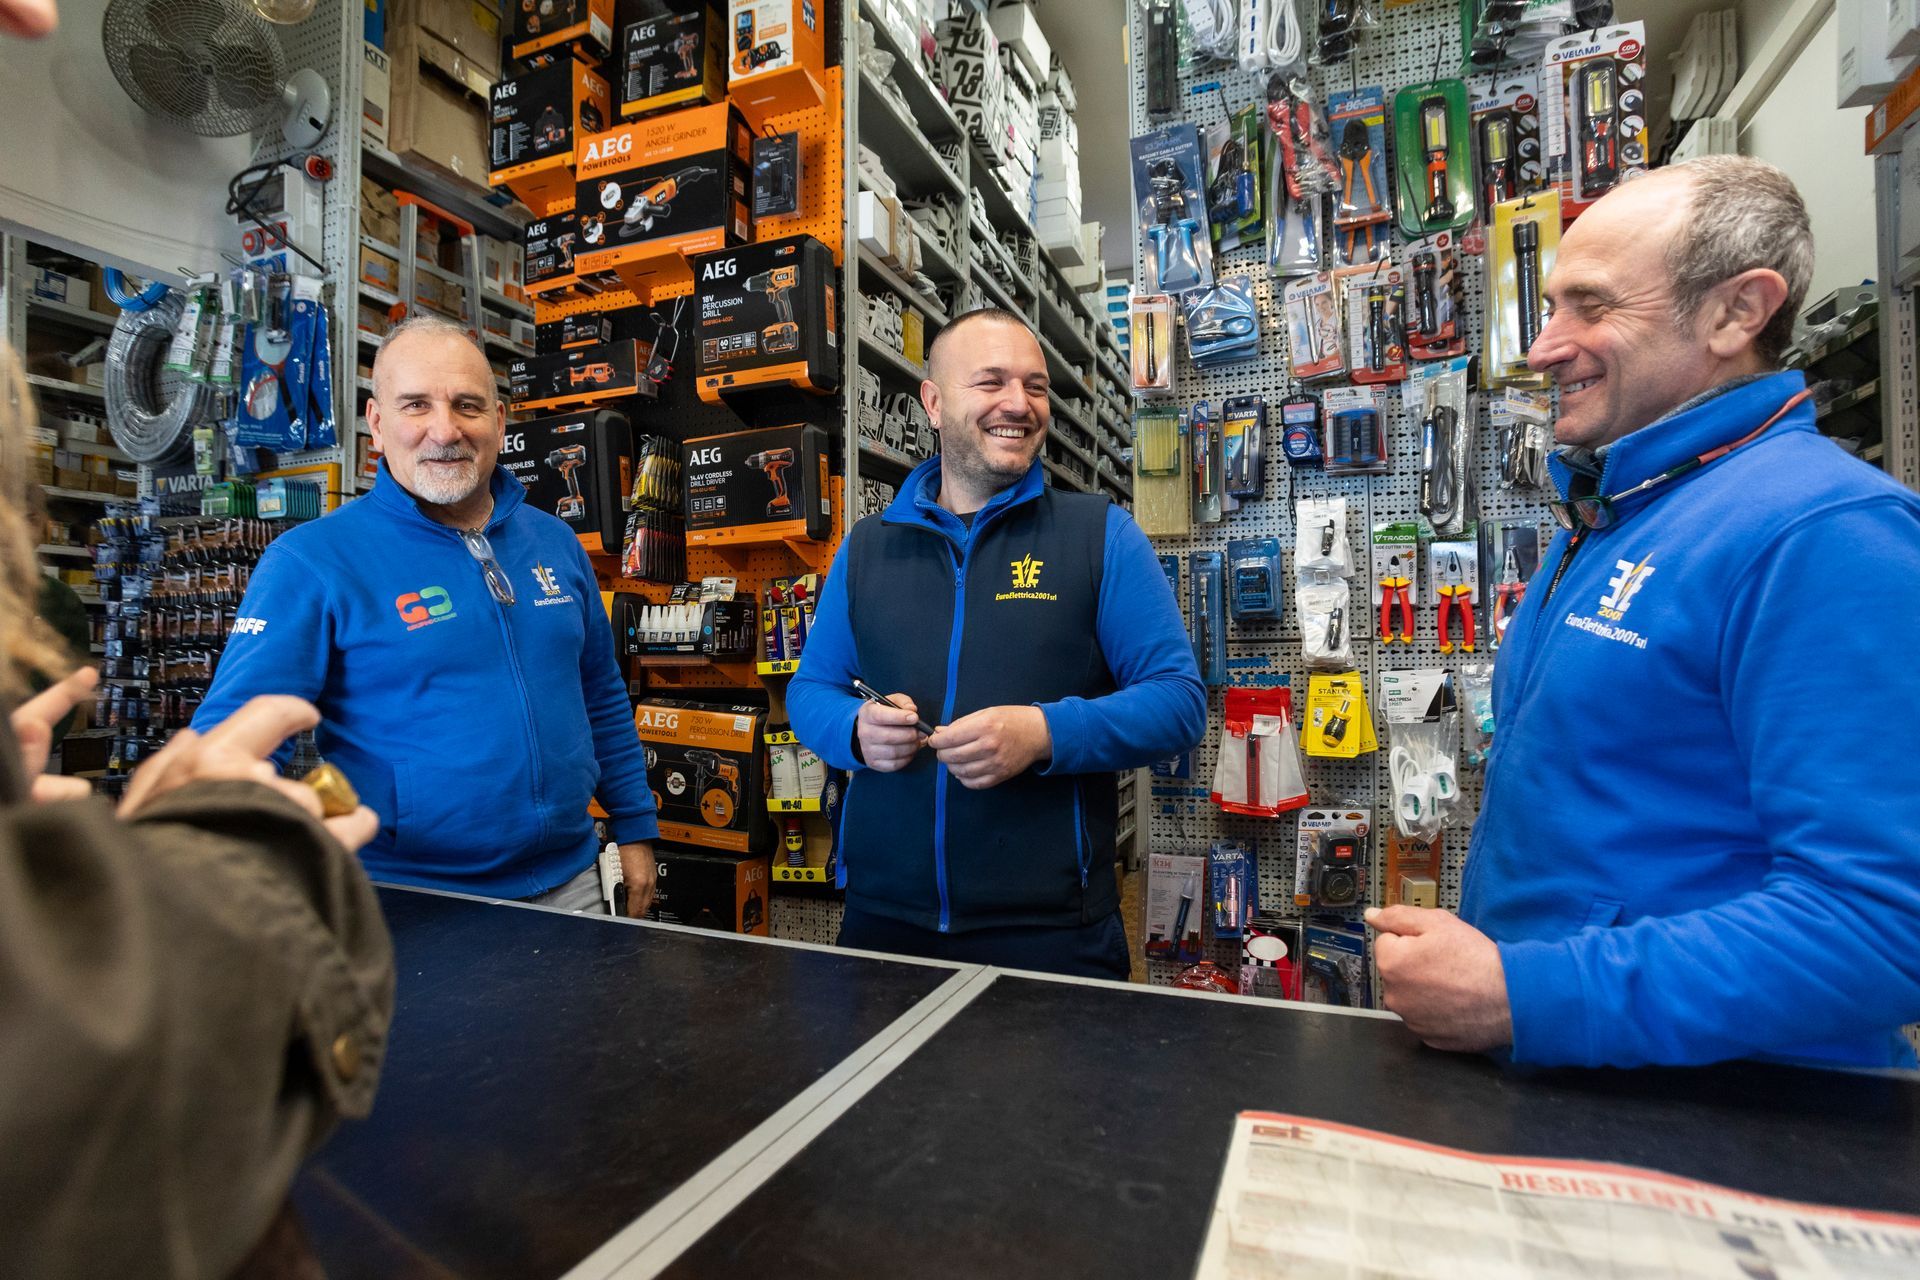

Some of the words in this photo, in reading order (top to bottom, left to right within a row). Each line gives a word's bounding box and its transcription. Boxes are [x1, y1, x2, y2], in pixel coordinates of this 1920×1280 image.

[630, 23, 656, 43] AEG
[1562, 45, 1600, 59] VELAMP
[494, 82, 517, 100] AEG
[582, 73, 604, 97] AEG
[673, 127, 708, 143] GRINDER
[584, 133, 632, 163] AEG
[582, 155, 632, 172] POWERTOOLS
[527, 222, 548, 239] AEG
[702, 258, 737, 282] AEG
[776, 273, 788, 281] AEG
[1295, 284, 1327, 299] VELAMP
[702, 295, 714, 303] 18V
[702, 297, 743, 311] PERCUSSION
[702, 309, 721, 319] DRILL
[511, 362, 526, 373] AEG
[1233, 410, 1258, 419] VARTA
[500, 433, 525, 455] EG
[690, 447, 722, 467] AEG
[705, 470, 733, 480] CORDLESS
[168, 475, 214, 495] VARTA
[690, 480, 705, 488] DRILL
[706, 477, 726, 486] DRIVER
[743, 609, 754, 618] 21
[1597, 606, 1623, 621] 2001
[771, 662, 792, 672] WD-40
[640, 711, 679, 729] AEG
[691, 716, 704, 724] 750
[638, 728, 678, 738] POWERTOOLS
[689, 727, 730, 737] PERCUSSION
[781, 800, 802, 810] WD-40
[1212, 853, 1244, 861] VARTA
[744, 866, 763, 884] AEG
[1500, 1170, 1720, 1220] RESISTENTI
